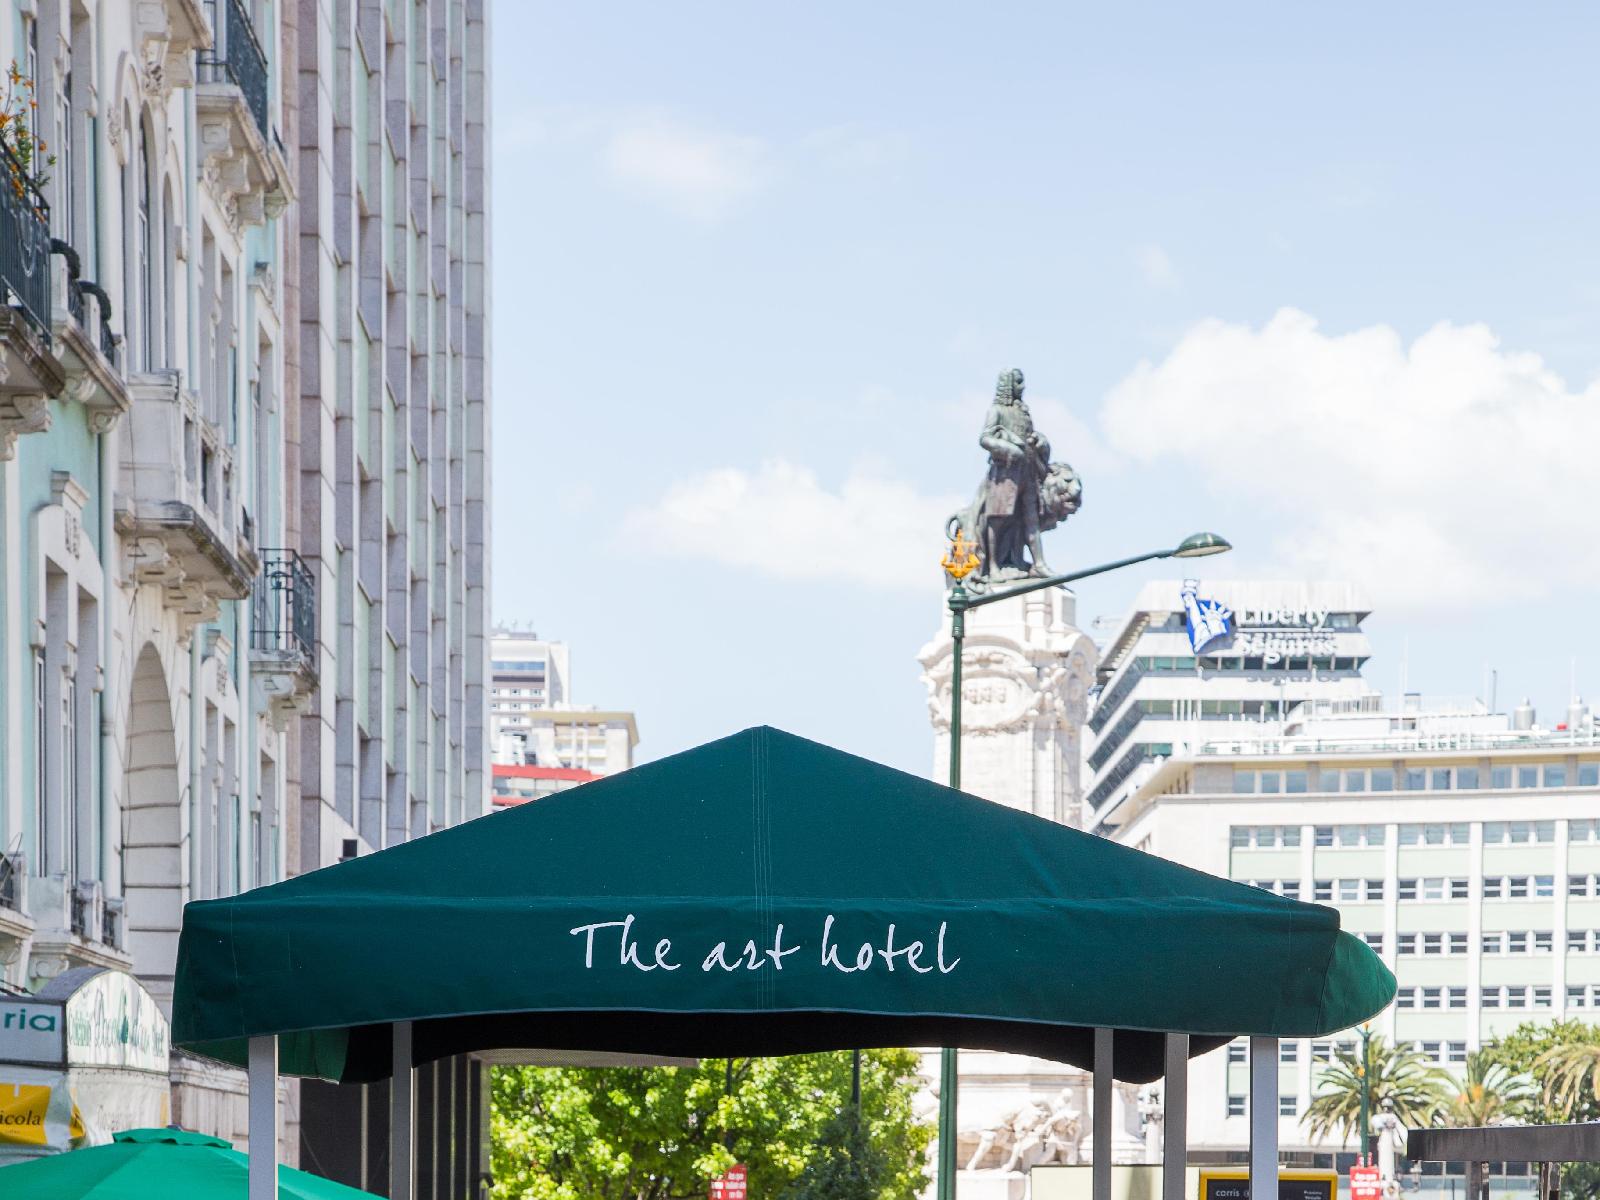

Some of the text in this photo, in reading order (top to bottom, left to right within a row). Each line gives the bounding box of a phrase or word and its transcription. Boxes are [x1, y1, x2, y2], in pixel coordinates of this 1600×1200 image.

[1234, 635, 1338, 664] Seguros
[570, 914, 961, 974] The art hotel
[4, 1009, 56, 1032] ria
